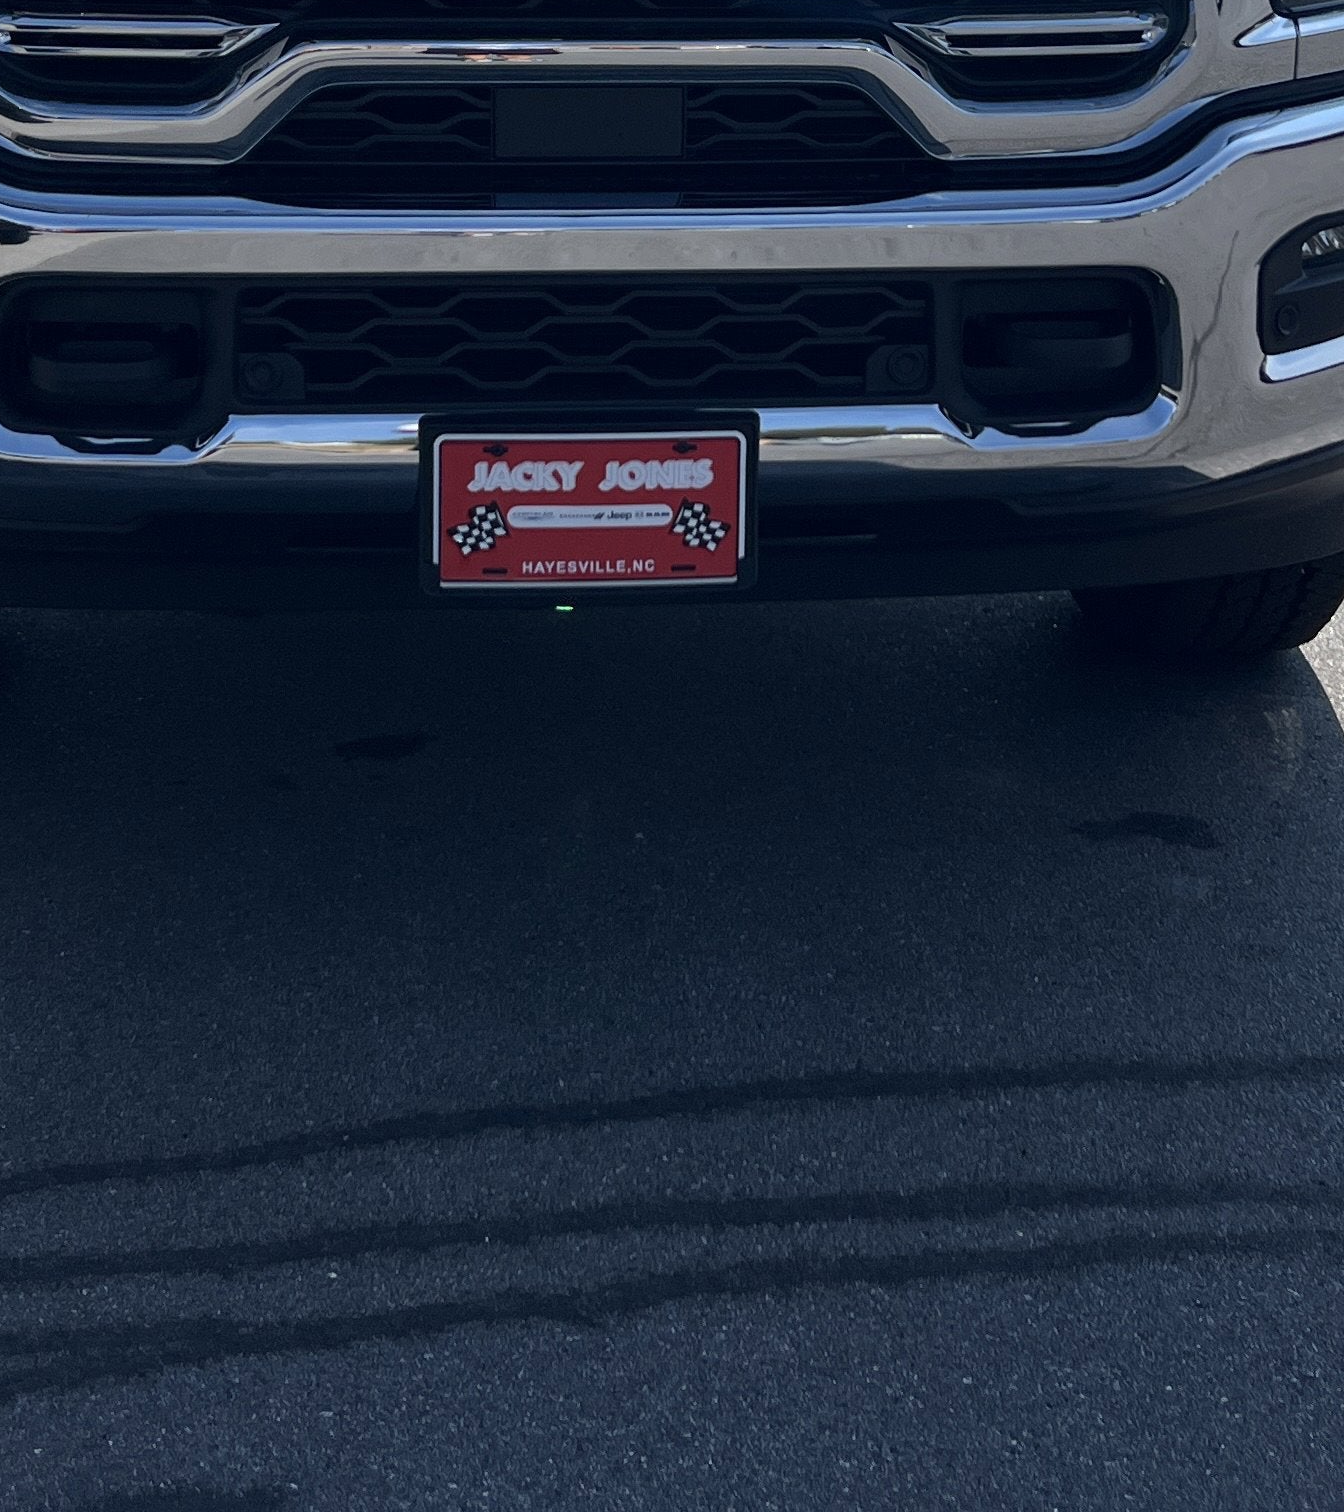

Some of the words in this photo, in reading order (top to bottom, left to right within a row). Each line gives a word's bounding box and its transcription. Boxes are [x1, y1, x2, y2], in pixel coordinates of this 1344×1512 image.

[467, 461, 584, 492] JACKY
[598, 458, 714, 491] JONES
[607, 510, 632, 521] Jeep
